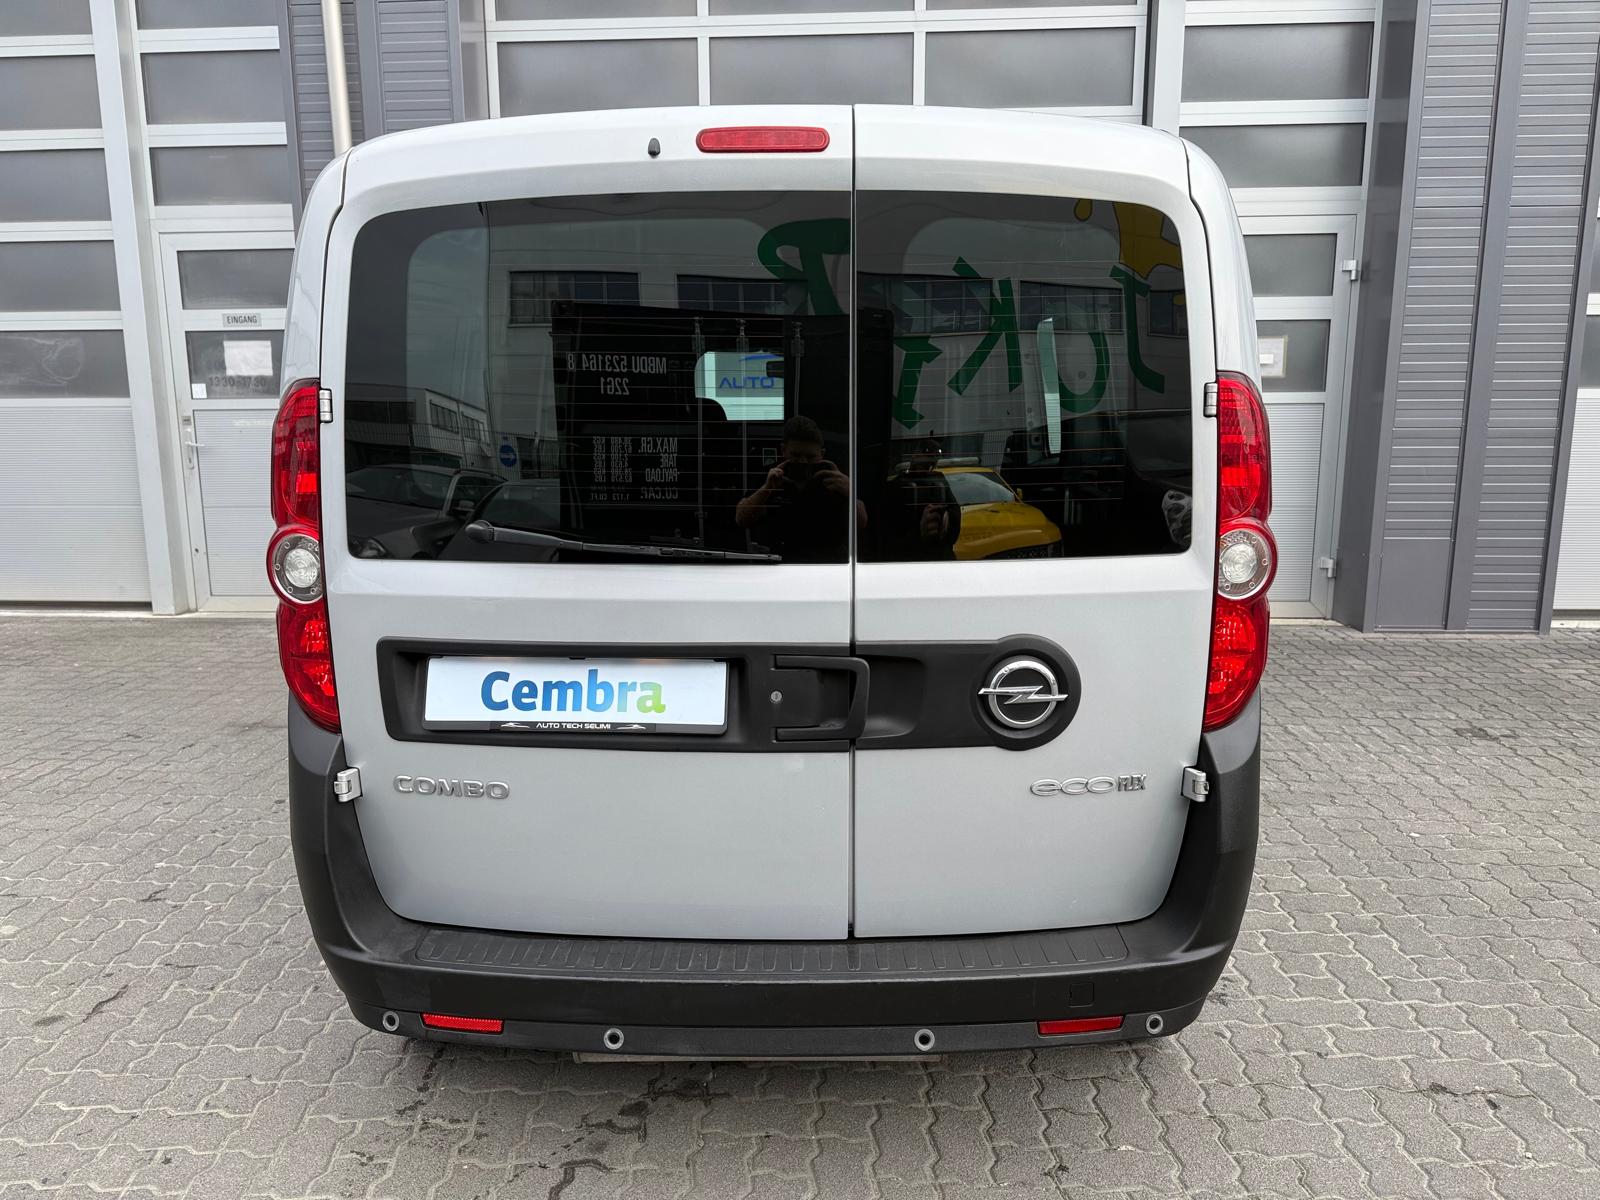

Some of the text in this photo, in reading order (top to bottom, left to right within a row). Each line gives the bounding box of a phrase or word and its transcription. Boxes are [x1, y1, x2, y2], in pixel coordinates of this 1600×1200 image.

[226, 315, 257, 324] EINGANG
[719, 376, 774, 389] AUTO
[481, 669, 667, 715] Cembra
[536, 722, 560, 730] AUTO
[584, 723, 611, 731] SELIMI
[393, 775, 510, 800] COMBO
